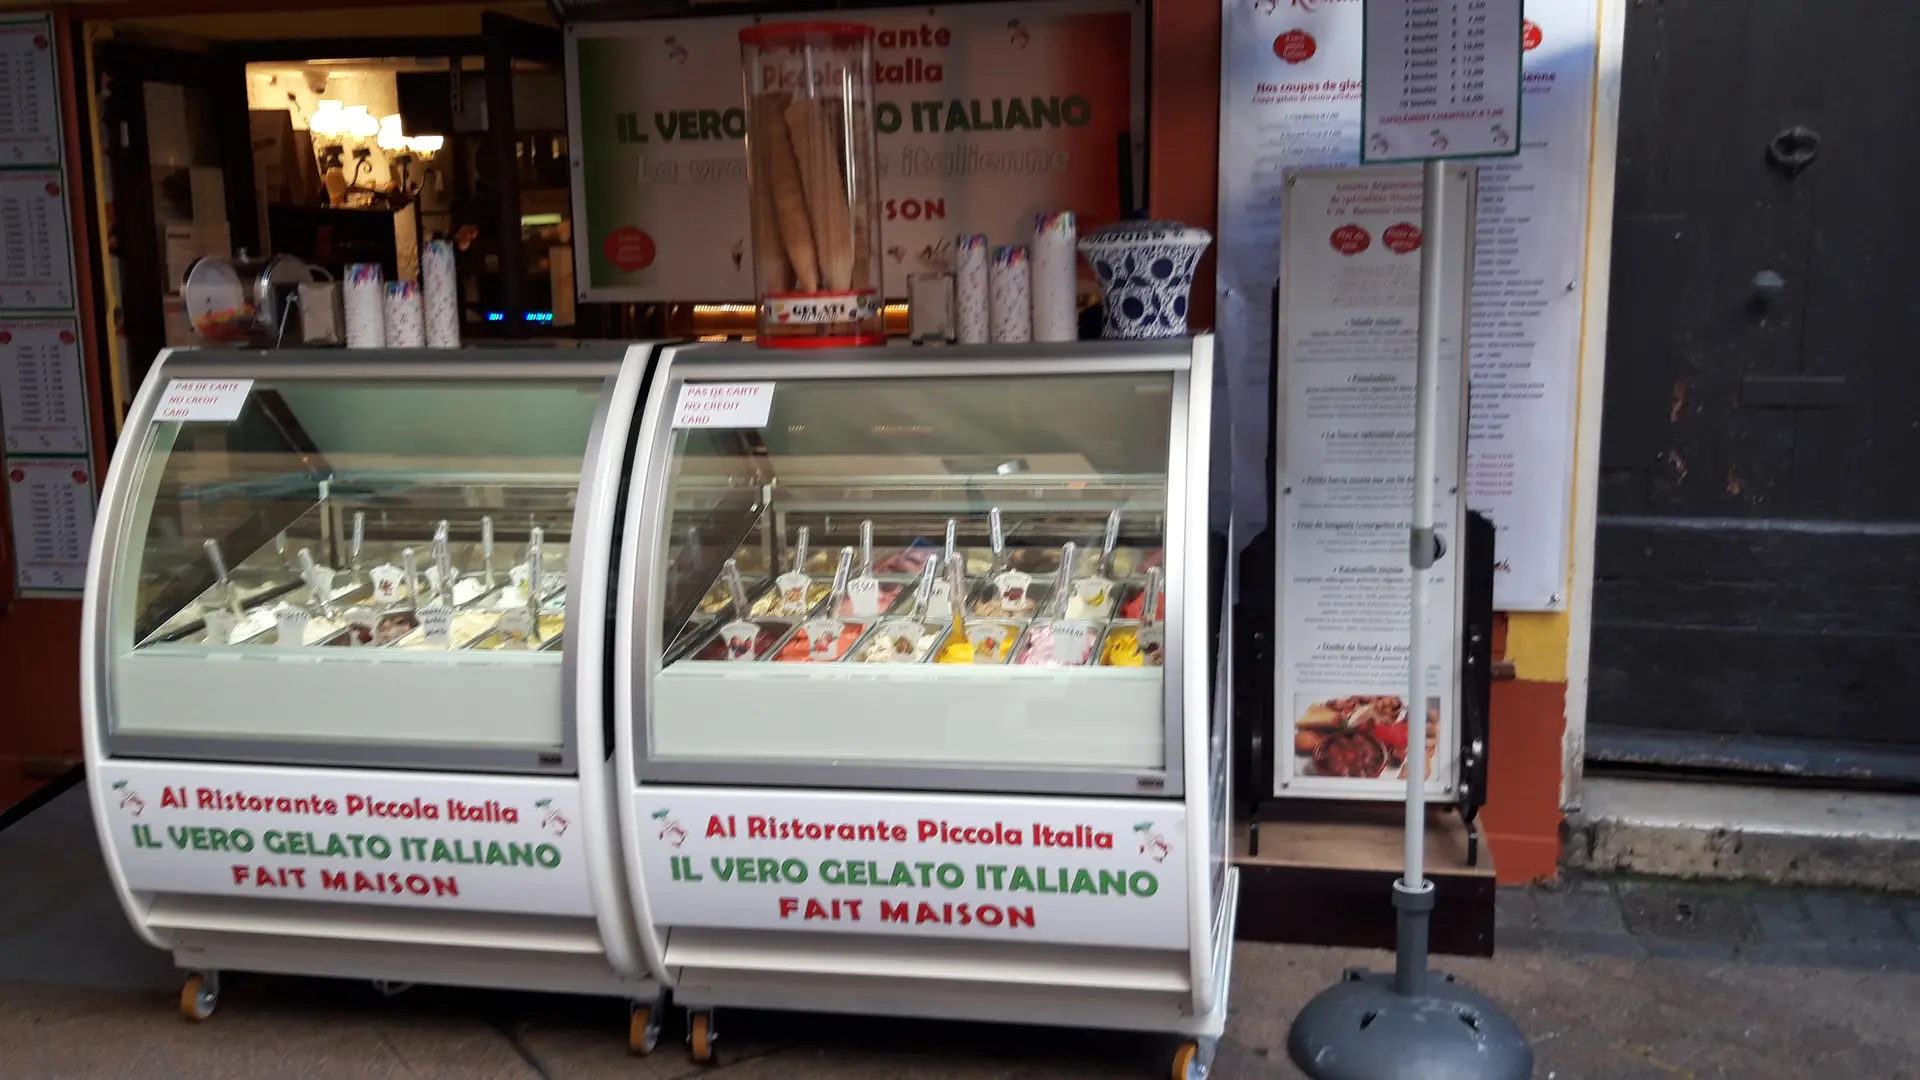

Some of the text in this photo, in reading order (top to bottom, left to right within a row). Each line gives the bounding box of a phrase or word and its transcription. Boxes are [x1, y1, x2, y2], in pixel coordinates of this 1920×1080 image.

[1322, 80, 1337, 91] de
[616, 112, 649, 144] IL
[654, 108, 746, 142] VERO
[911, 94, 1093, 134] ITALIANO
[637, 154, 679, 184] La
[690, 158, 746, 184] vra
[902, 146, 1069, 177] italienne
[792, 303, 845, 317] GELATI
[174, 382, 240, 391] PAS DE CARTE
[687, 386, 761, 397] PAS DE CARTE
[168, 395, 219, 405] NO CREDIT
[684, 401, 740, 411] NO CREDIT
[162, 408, 189, 418] CARD
[681, 415, 710, 425] CARD
[160, 786, 520, 825] Al Ristorante Piccola Italia
[704, 815, 1114, 850] Al Ristorante Piccola Italia
[131, 823, 562, 870] IL VERO GELATO ITALIANO
[230, 864, 460, 898] FAIT MAISON
[670, 855, 1159, 898] IL VERO GELATO ITALIANO
[779, 896, 1036, 929] FAIT MAISON
